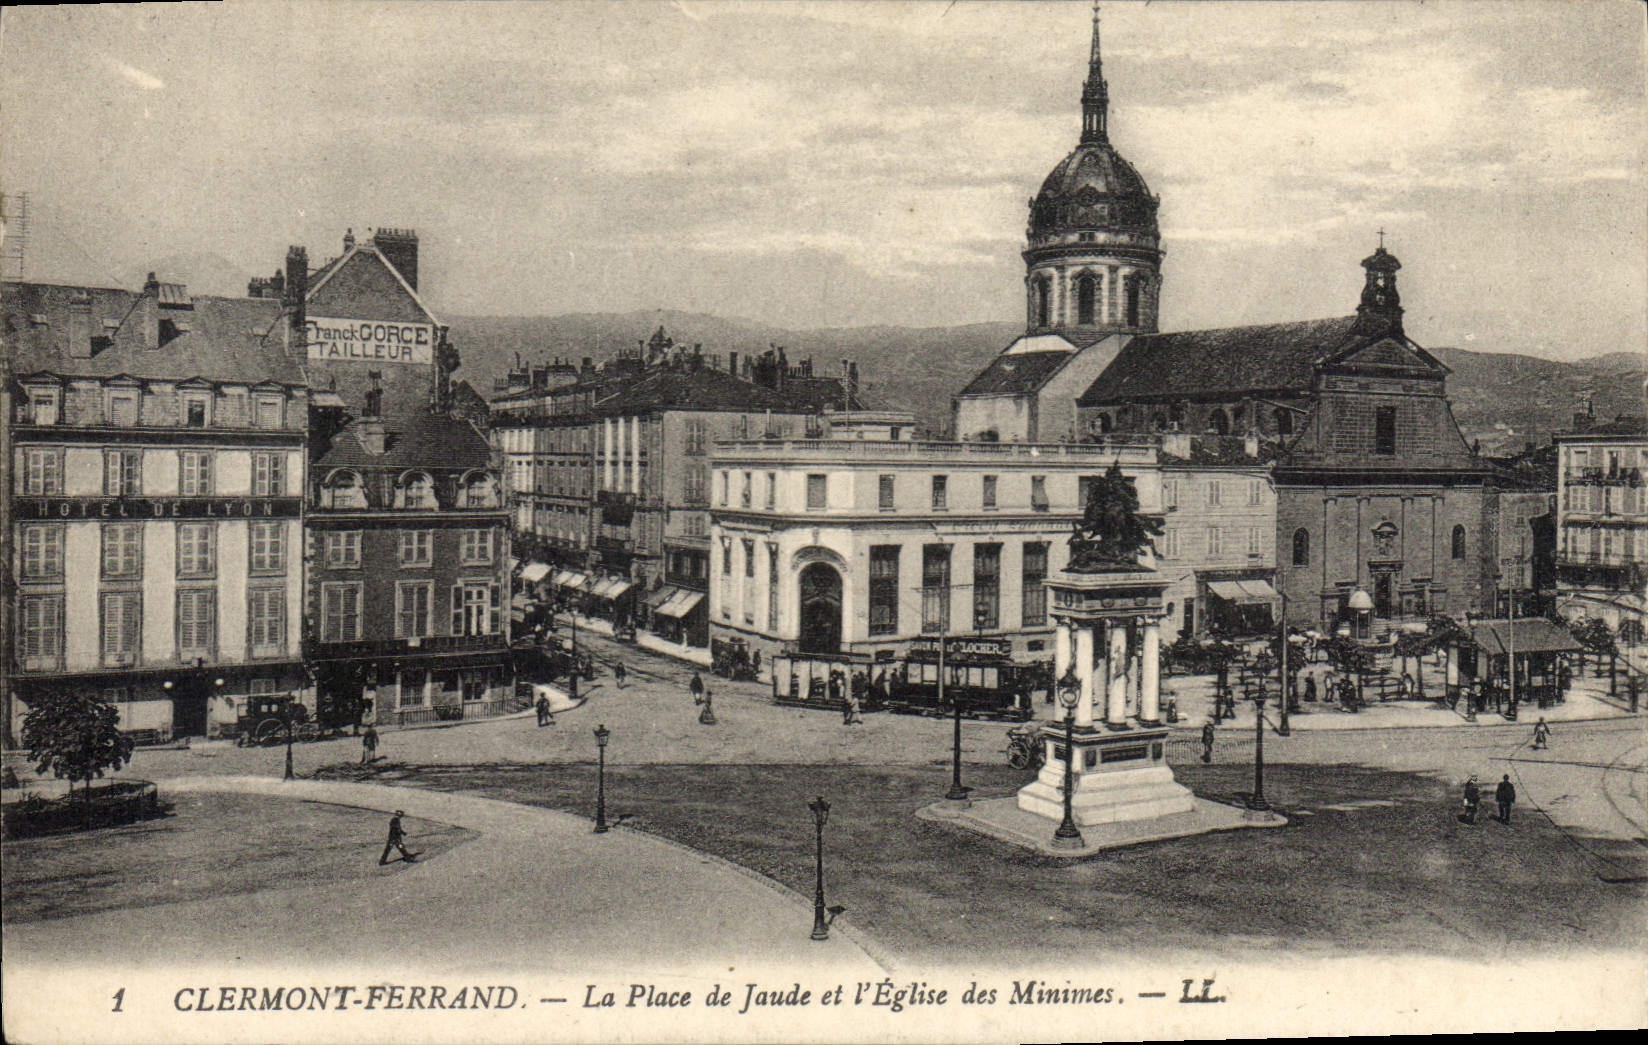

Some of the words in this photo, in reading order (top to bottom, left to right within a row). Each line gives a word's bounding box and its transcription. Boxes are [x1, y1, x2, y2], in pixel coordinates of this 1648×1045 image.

[359, 323, 429, 346] GORCE
[318, 341, 413, 361] TAILLEUR
[38, 503, 128, 516] HOTEL
[152, 503, 181, 517] DE
[206, 503, 272, 516] LYON
